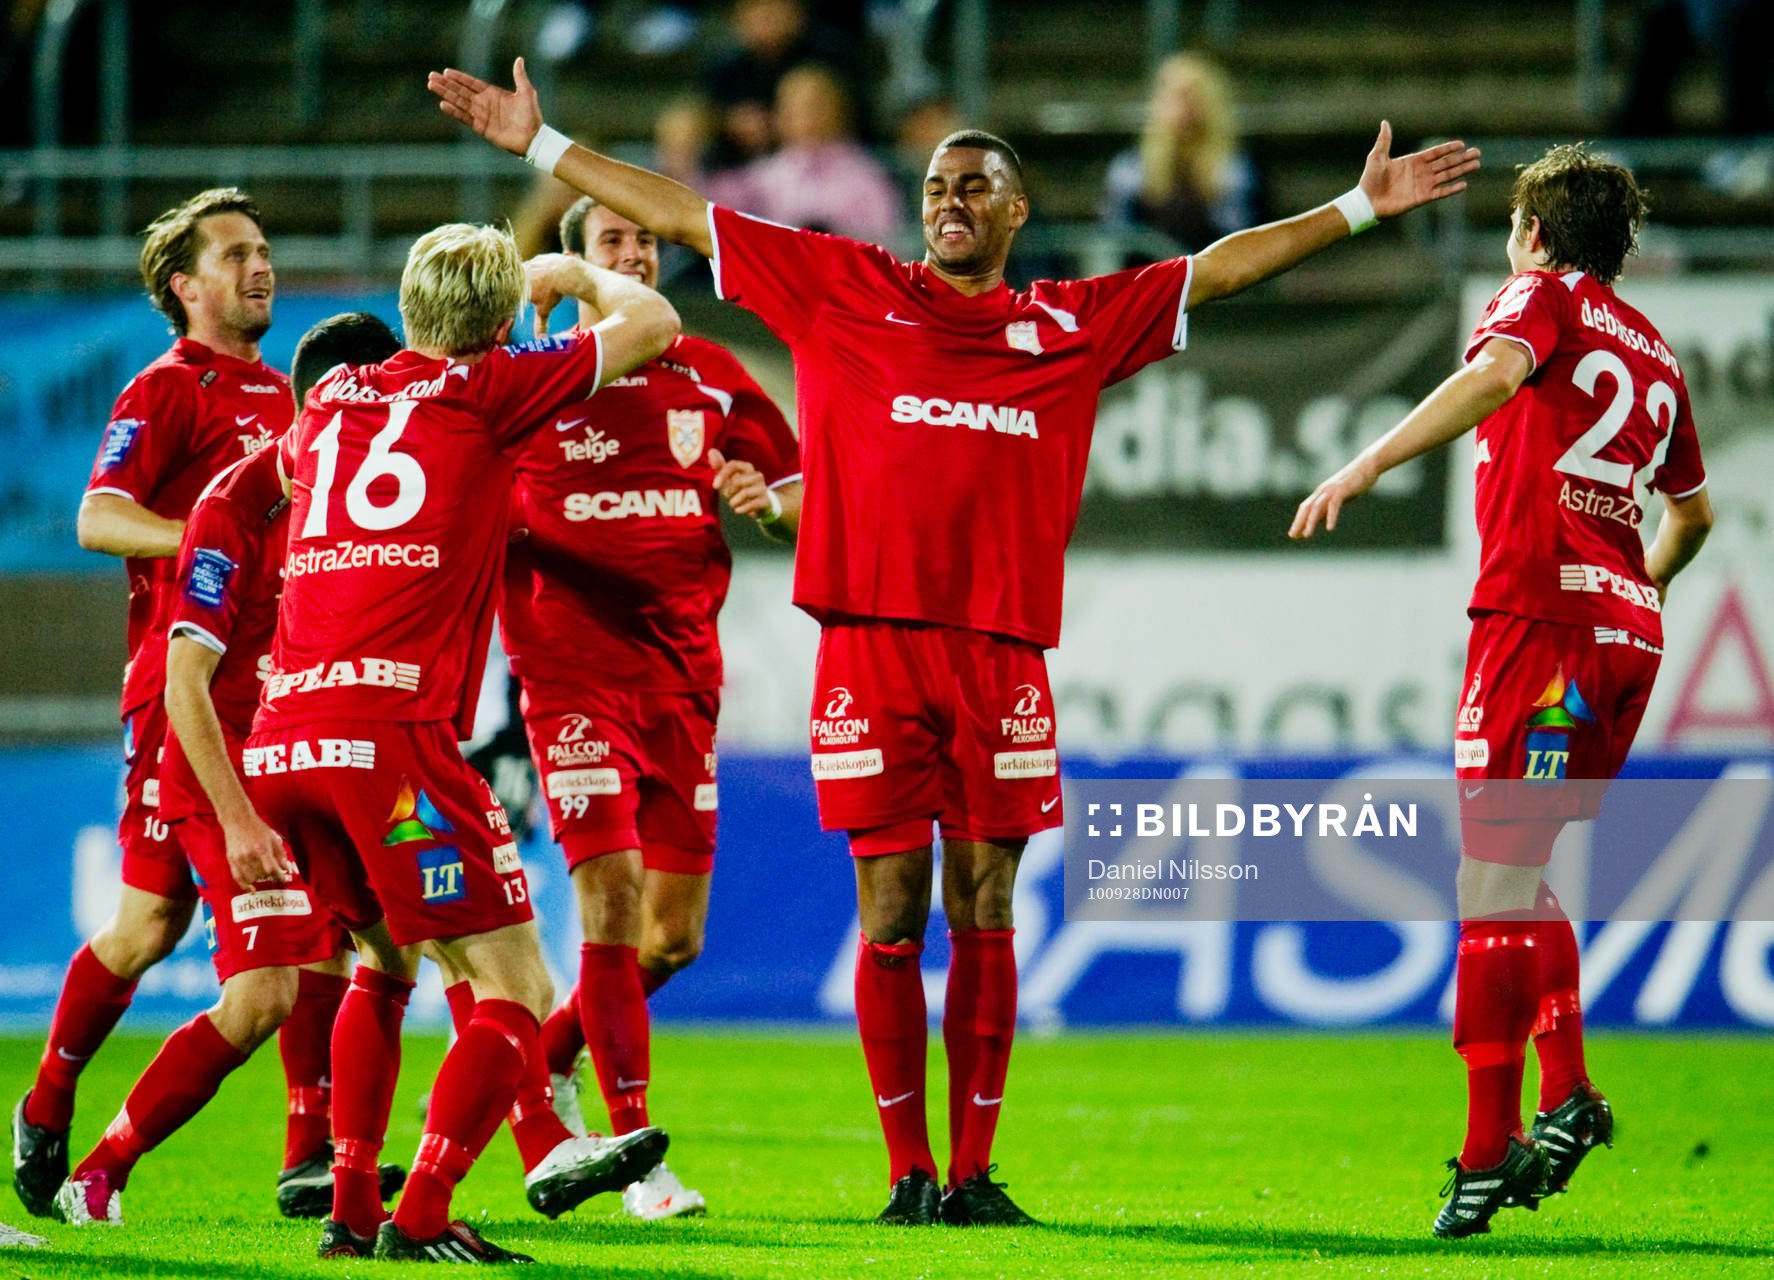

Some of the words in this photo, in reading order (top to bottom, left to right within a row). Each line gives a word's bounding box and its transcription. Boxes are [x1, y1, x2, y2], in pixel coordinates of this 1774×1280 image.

[890, 395, 1040, 440] SCANIA
[1553, 350, 1678, 497] 22
[559, 426, 621, 463] Telge
[302, 400, 427, 539] 16
[563, 489, 703, 522] SCANIA
[1558, 481, 1641, 529] AstraZe
[284, 541, 440, 581] AstraZeneca
[1579, 564, 1661, 614] PEAB
[280, 657, 398, 699] PEAB
[811, 717, 870, 738] FALCON
[1001, 717, 1052, 736] FALCON
[249, 738, 352, 777] PEAB
[547, 740, 610, 762] FALCON
[1522, 750, 1570, 779] LT
[560, 794, 590, 820] 99
[143, 815, 169, 842] 10
[421, 861, 465, 900] LT
[503, 877, 526, 906] 13
[242, 925, 260, 951] 7
